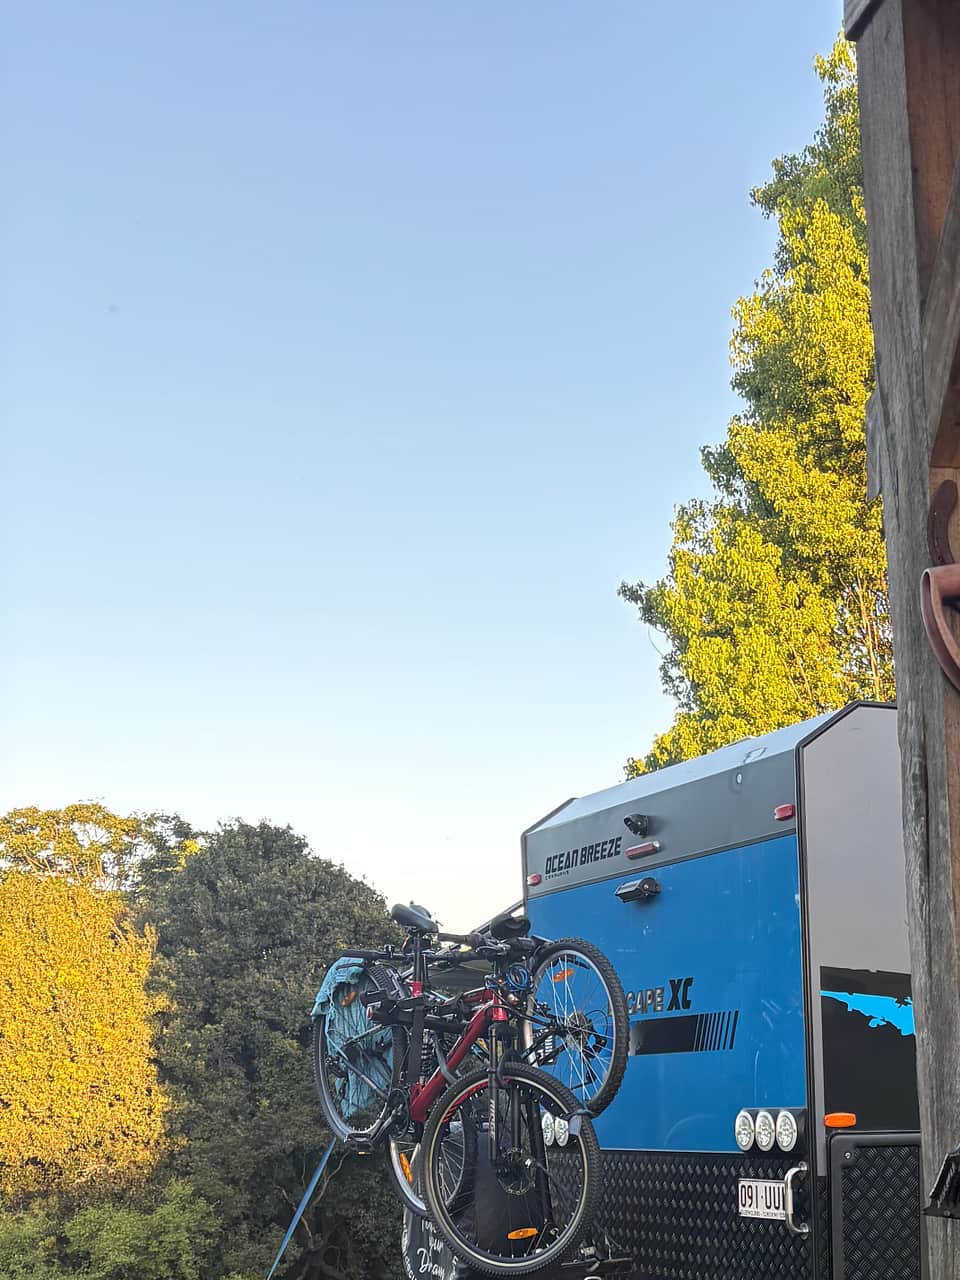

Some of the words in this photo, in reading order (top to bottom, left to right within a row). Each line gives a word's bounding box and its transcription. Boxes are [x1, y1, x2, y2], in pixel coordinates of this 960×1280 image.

[545, 849, 579, 875] OCEAN
[580, 836, 623, 866] BREEZE
[608, 987, 664, 1015] CAPE
[667, 976, 694, 1011] XC
